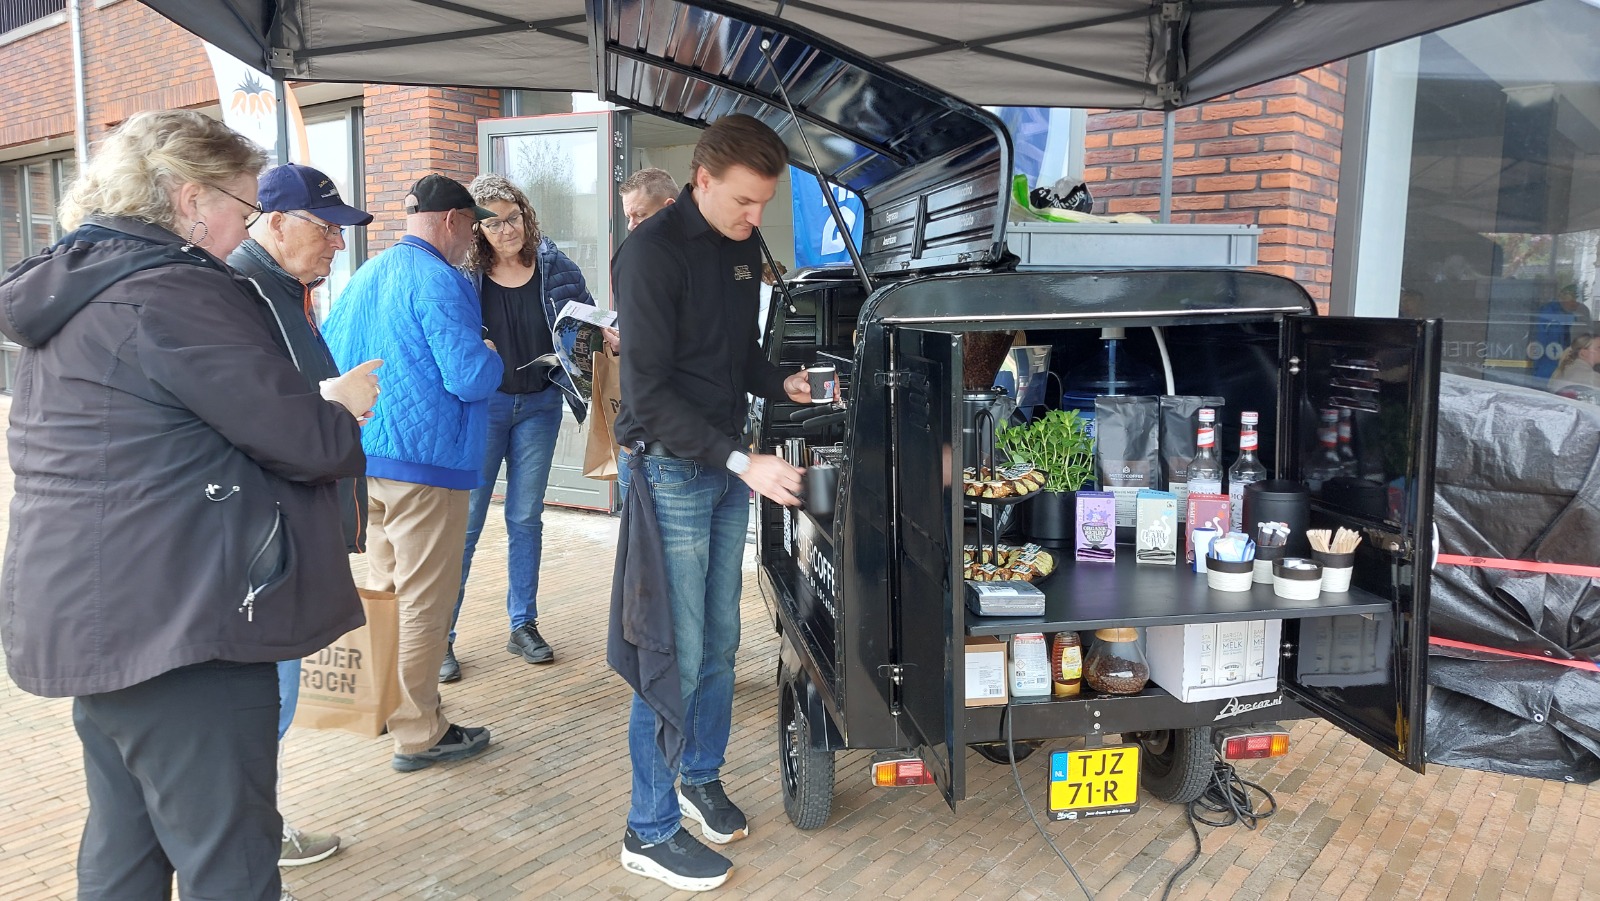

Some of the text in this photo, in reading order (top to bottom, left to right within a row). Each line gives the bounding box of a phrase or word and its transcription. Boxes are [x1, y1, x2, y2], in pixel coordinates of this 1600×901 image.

[792, 518, 835, 597] MISTERCOFFE
[1222, 631, 1243, 639] BARISTA
[1222, 640, 1243, 650] MELK
[1078, 752, 1124, 777] TJZ
[1054, 770, 1064, 778] NL
[1068, 780, 1118, 805] 71-R
